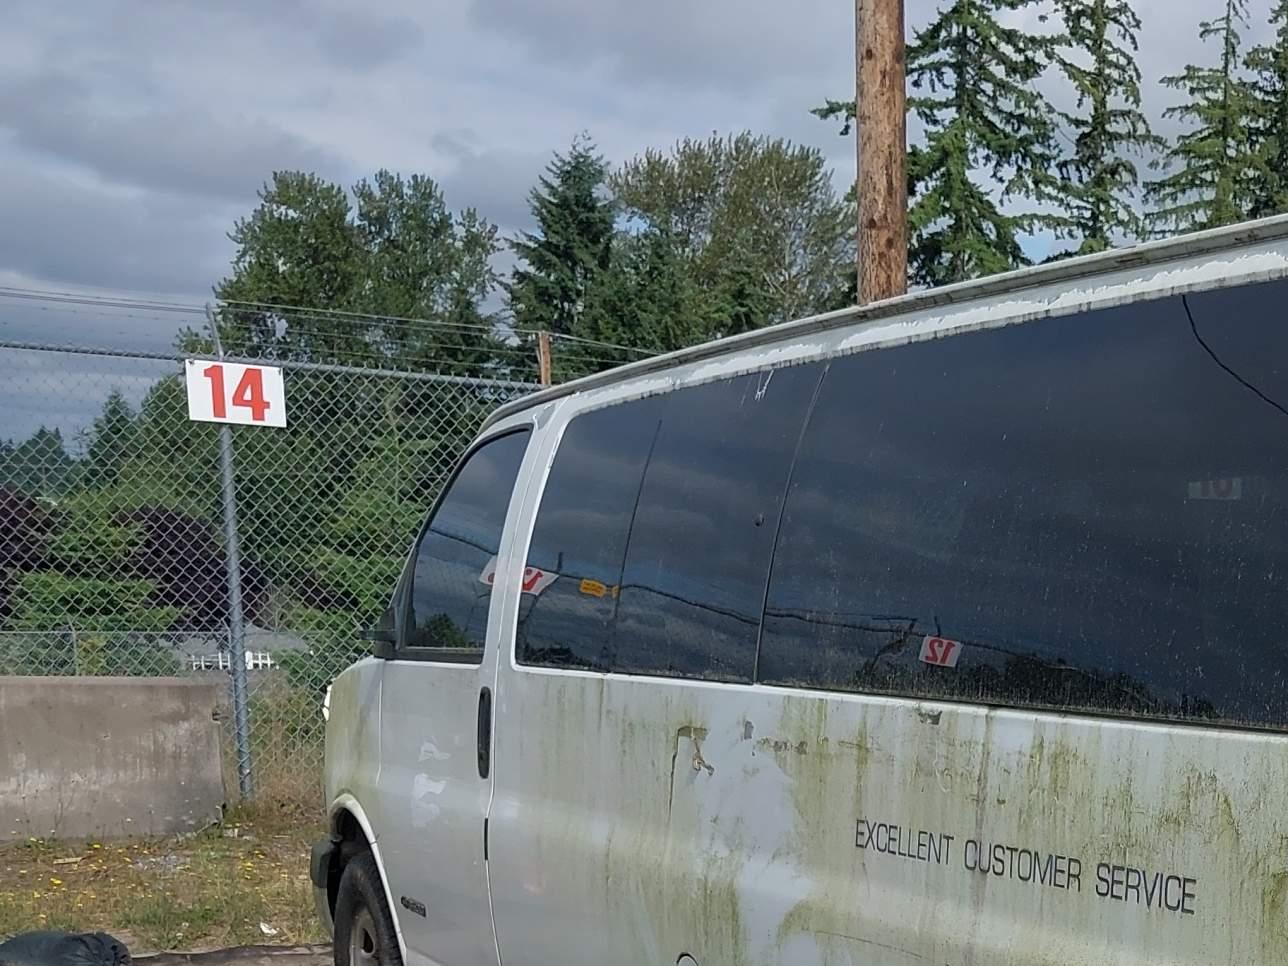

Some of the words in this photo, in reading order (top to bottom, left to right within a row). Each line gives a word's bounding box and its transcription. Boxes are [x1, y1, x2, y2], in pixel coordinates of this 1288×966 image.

[203, 364, 270, 421] 14
[855, 819, 954, 865] EXCELLENT
[964, 839, 1081, 893] CUSTOMER
[1095, 862, 1197, 915] SERVICE
